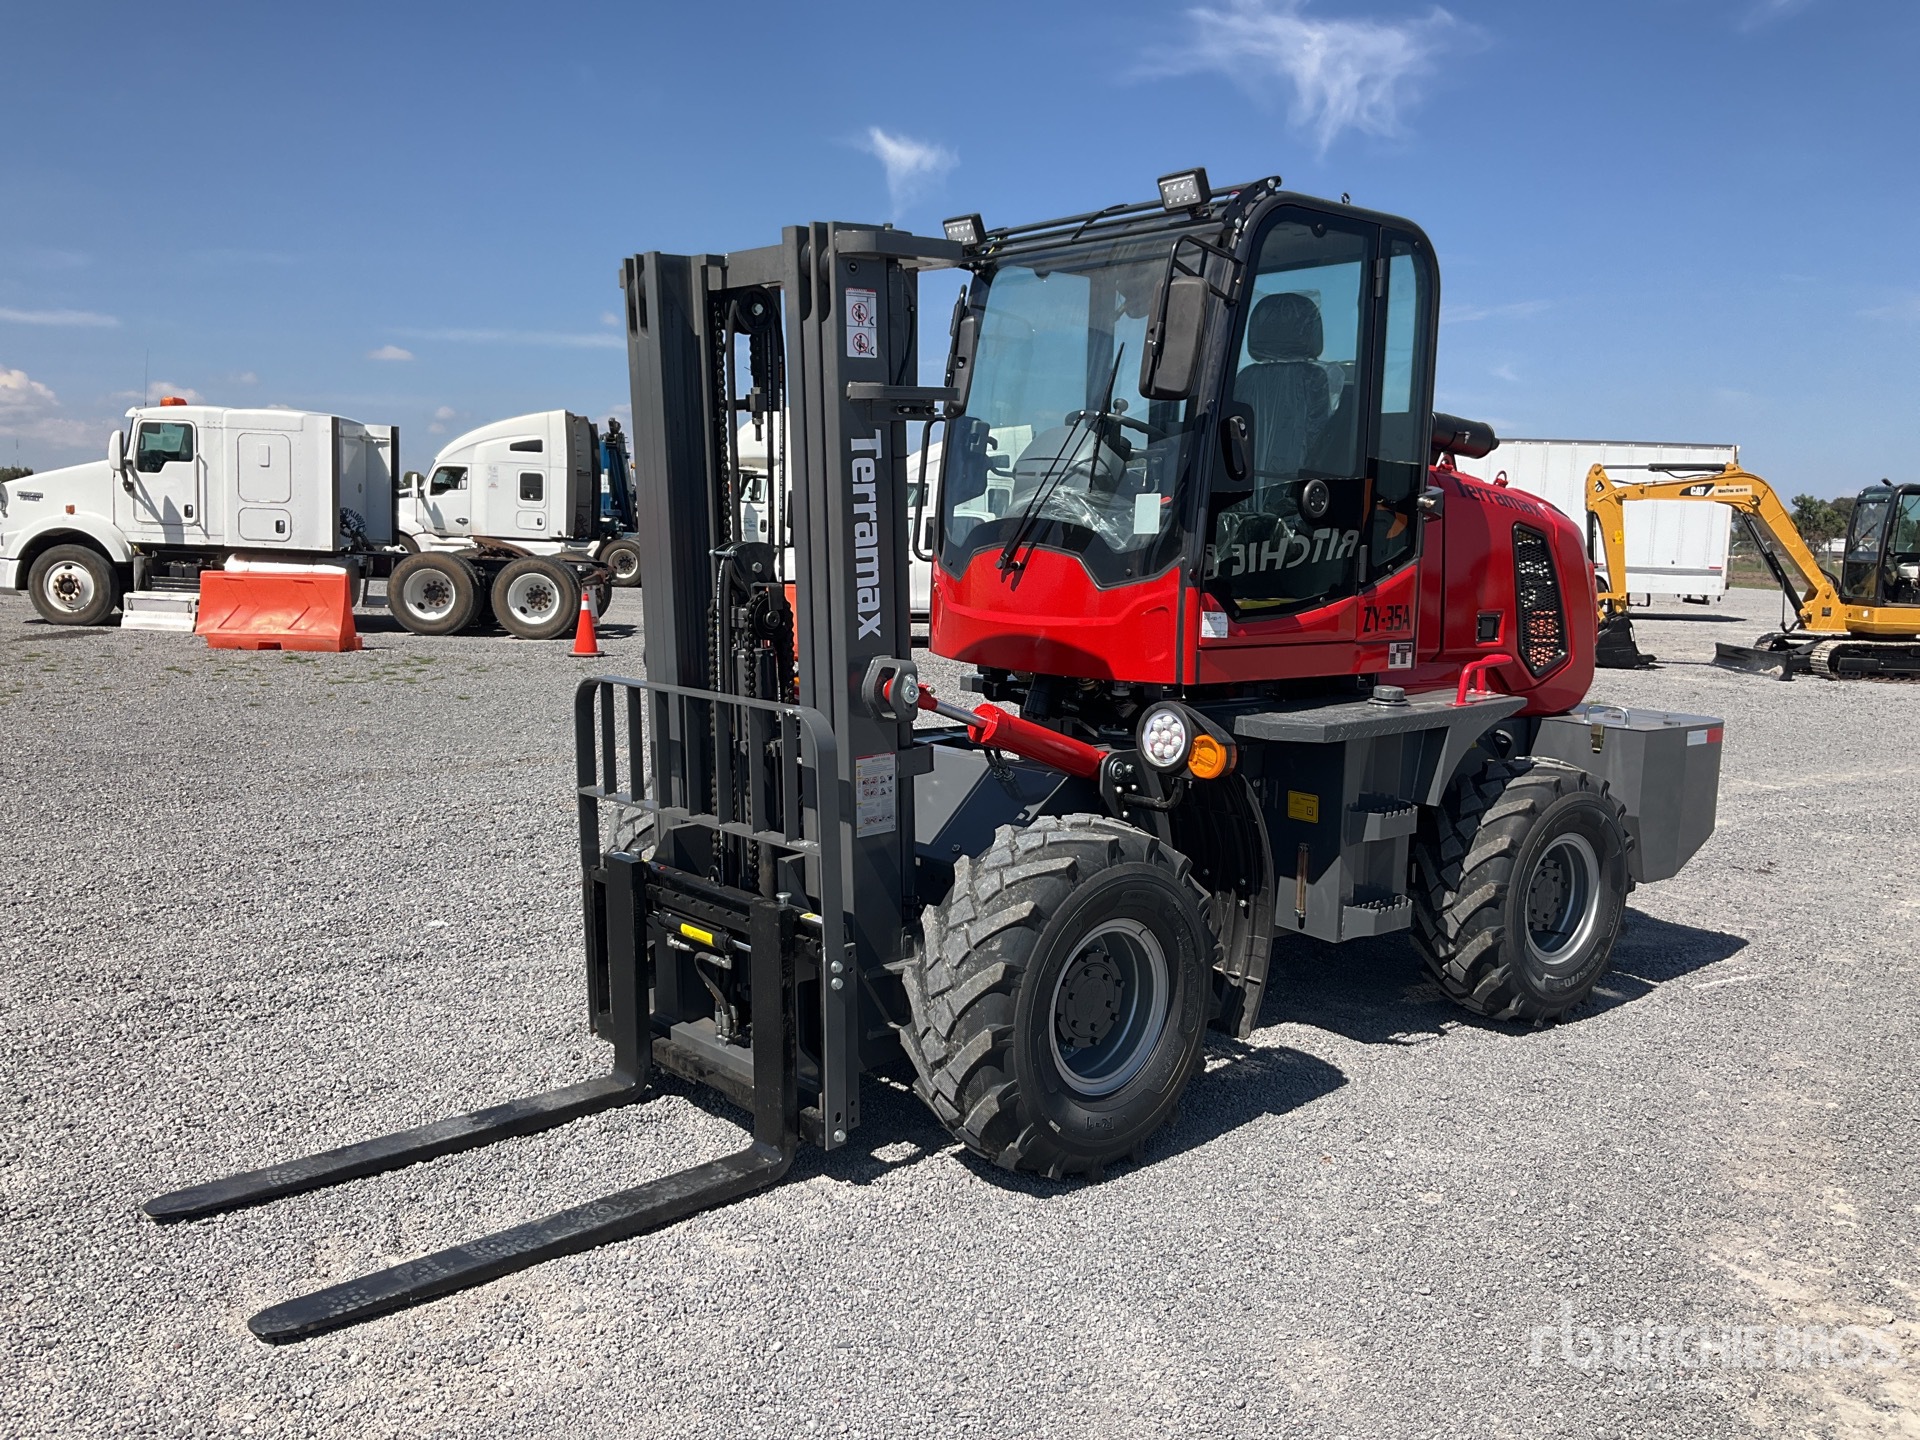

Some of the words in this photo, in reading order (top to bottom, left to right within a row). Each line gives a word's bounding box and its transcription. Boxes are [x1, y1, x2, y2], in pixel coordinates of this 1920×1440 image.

[1452, 476, 1545, 518] Terramax
[1690, 486, 1706, 496] CAT
[851, 429, 882, 640] Terramax
[1363, 605, 1411, 633] ZY-35A
